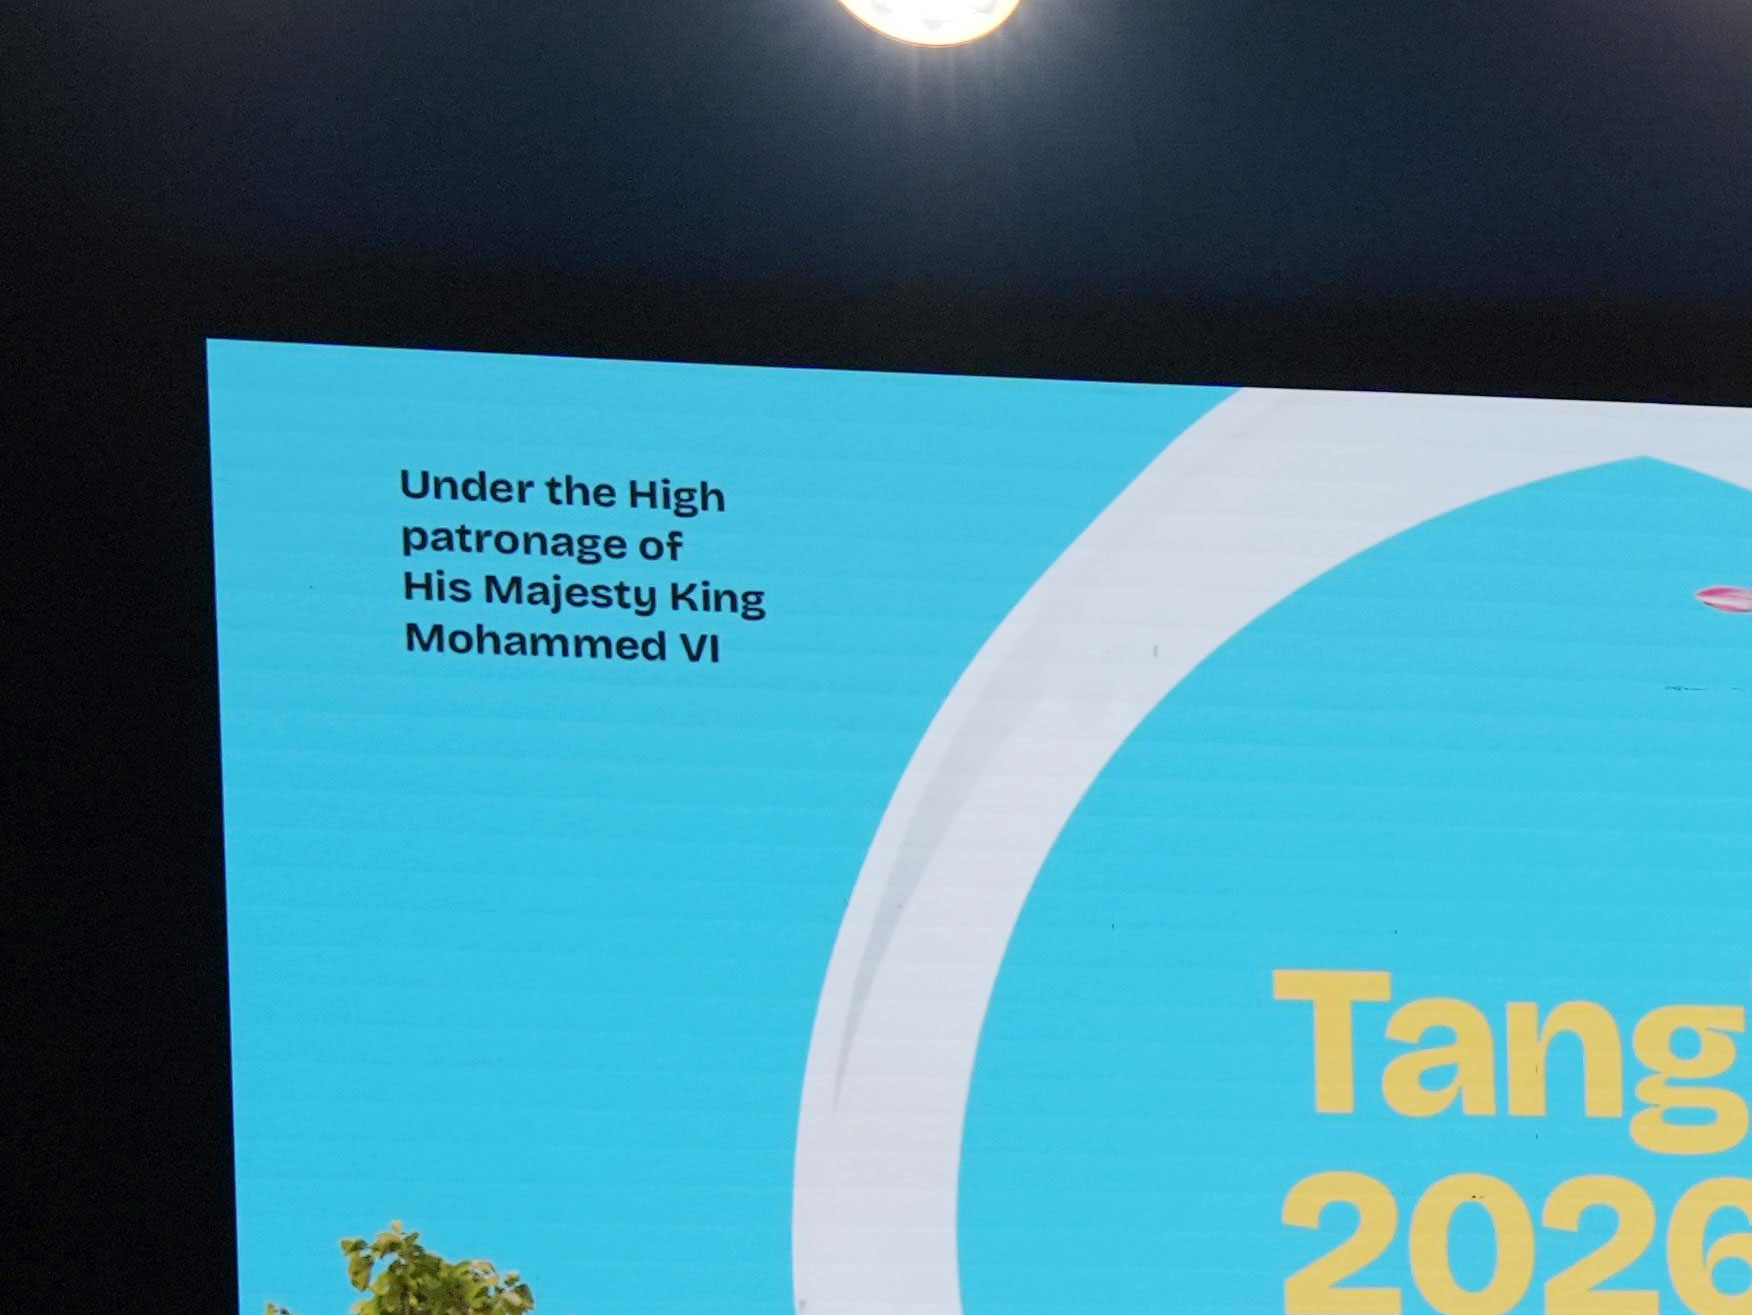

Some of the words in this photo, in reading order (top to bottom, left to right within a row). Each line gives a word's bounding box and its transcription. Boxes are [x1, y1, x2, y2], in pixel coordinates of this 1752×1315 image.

[400, 469, 535, 503] Under
[545, 475, 616, 508] the
[629, 479, 726, 518] High
[402, 521, 628, 565] patronage
[638, 531, 684, 562] of
[404, 571, 472, 603] His
[484, 575, 658, 618] Majesty
[670, 581, 767, 621] King
[405, 622, 667, 663] Mohammed
[680, 632, 721, 664] VI
